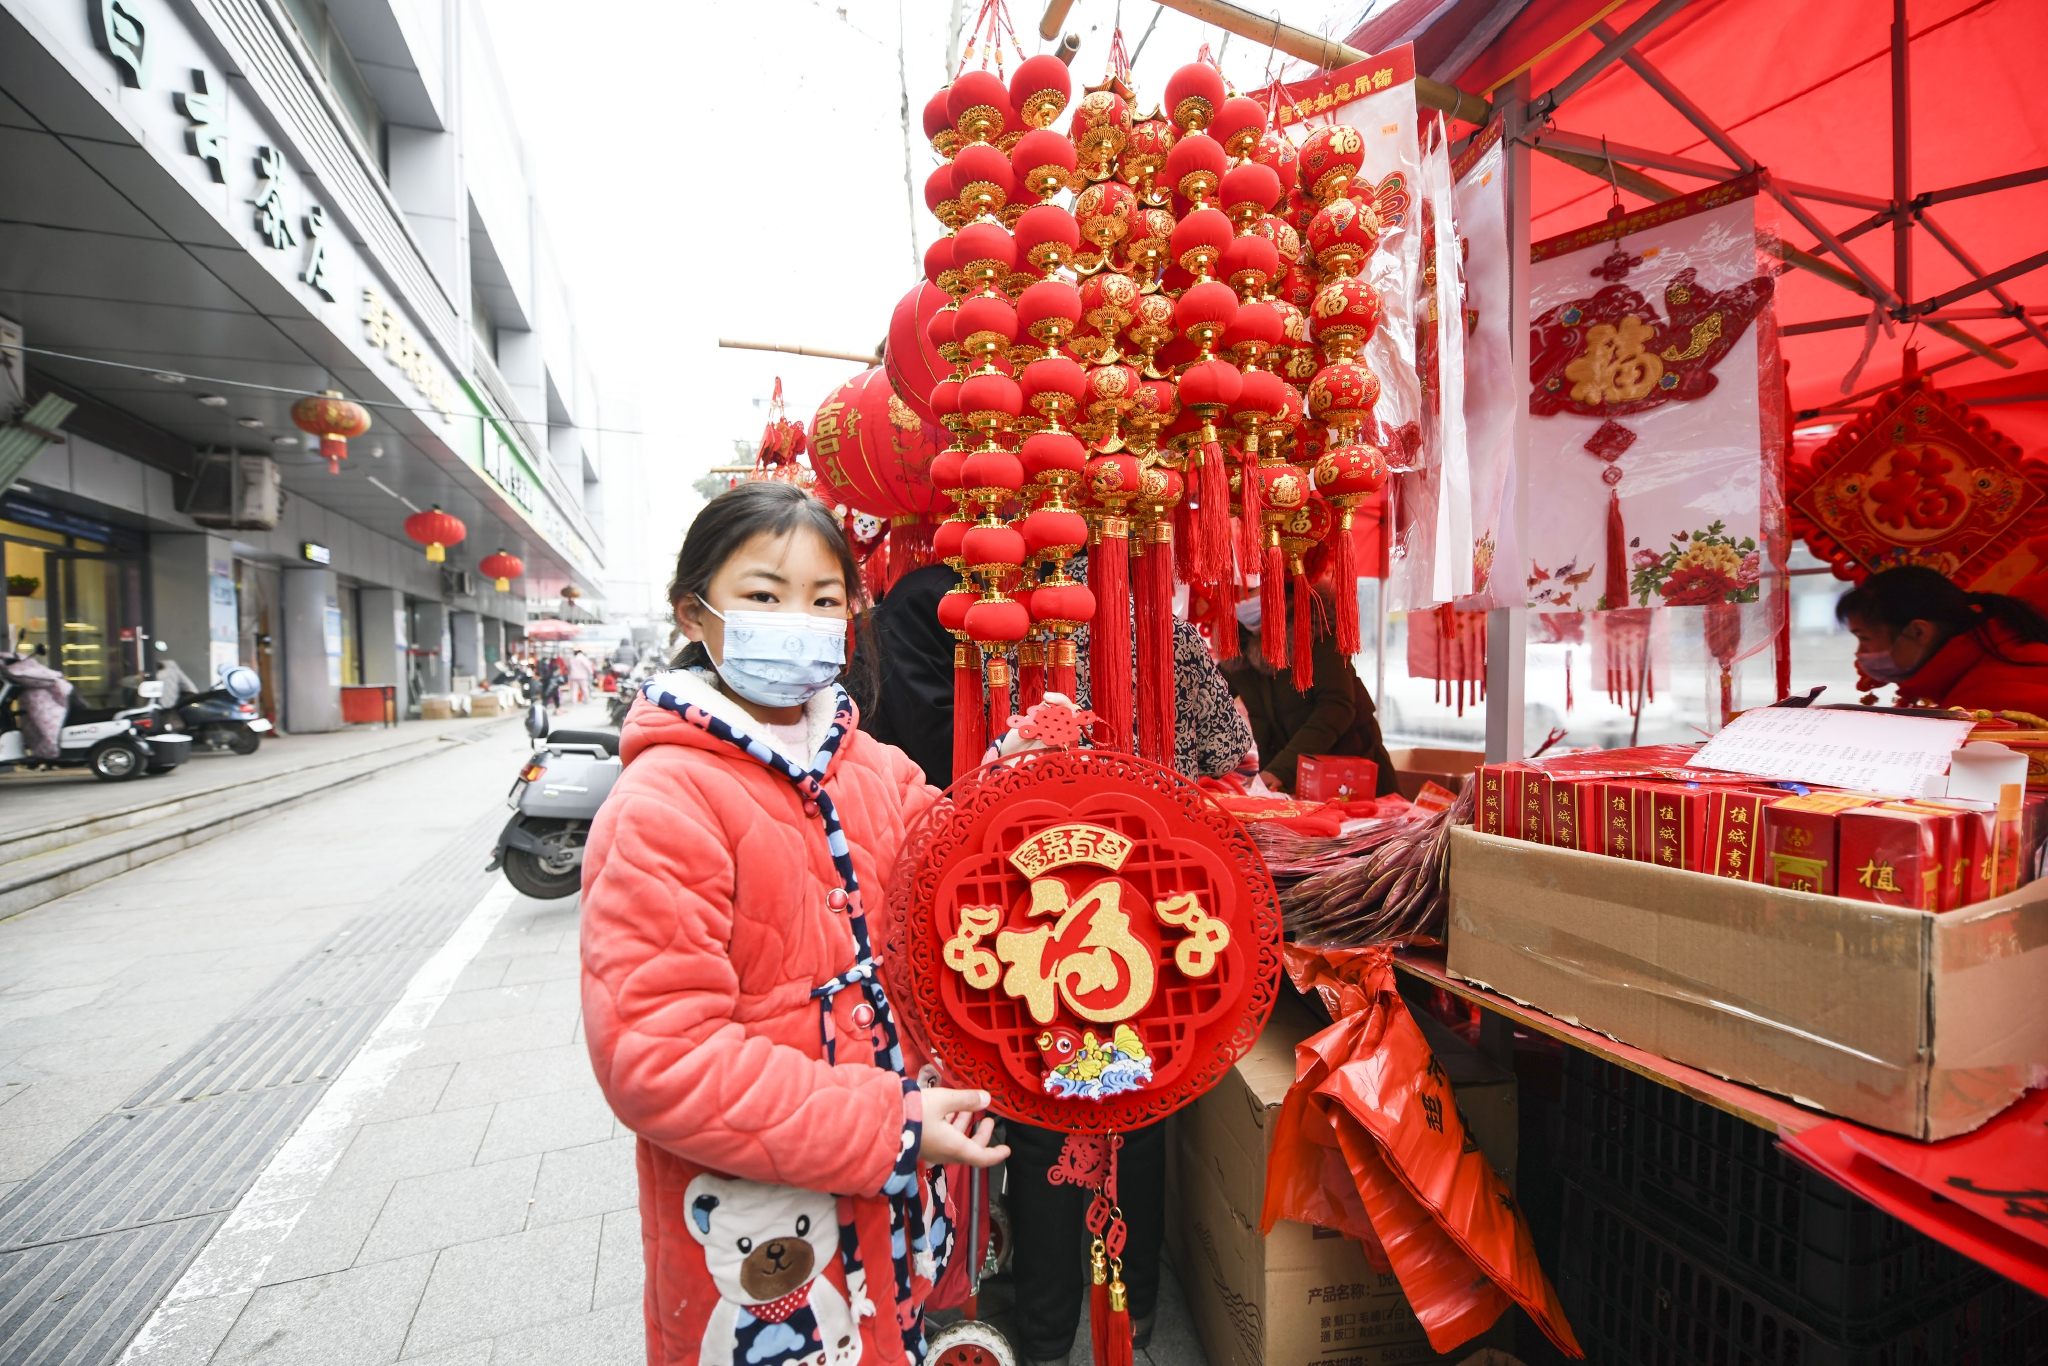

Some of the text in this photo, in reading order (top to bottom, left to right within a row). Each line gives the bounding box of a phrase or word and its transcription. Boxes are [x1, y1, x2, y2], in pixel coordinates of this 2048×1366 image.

[1328, 124, 1361, 155] 福
[1316, 284, 1349, 319] 福
[1565, 316, 1664, 405] 福
[1869, 448, 1967, 530] 福
[1856, 858, 1903, 893] 植
[996, 879, 1154, 1023] 福
[1307, 1273, 1401, 1305] 产品名称： 悦
[1381, 1345, 1433, 1362] 58X38X
